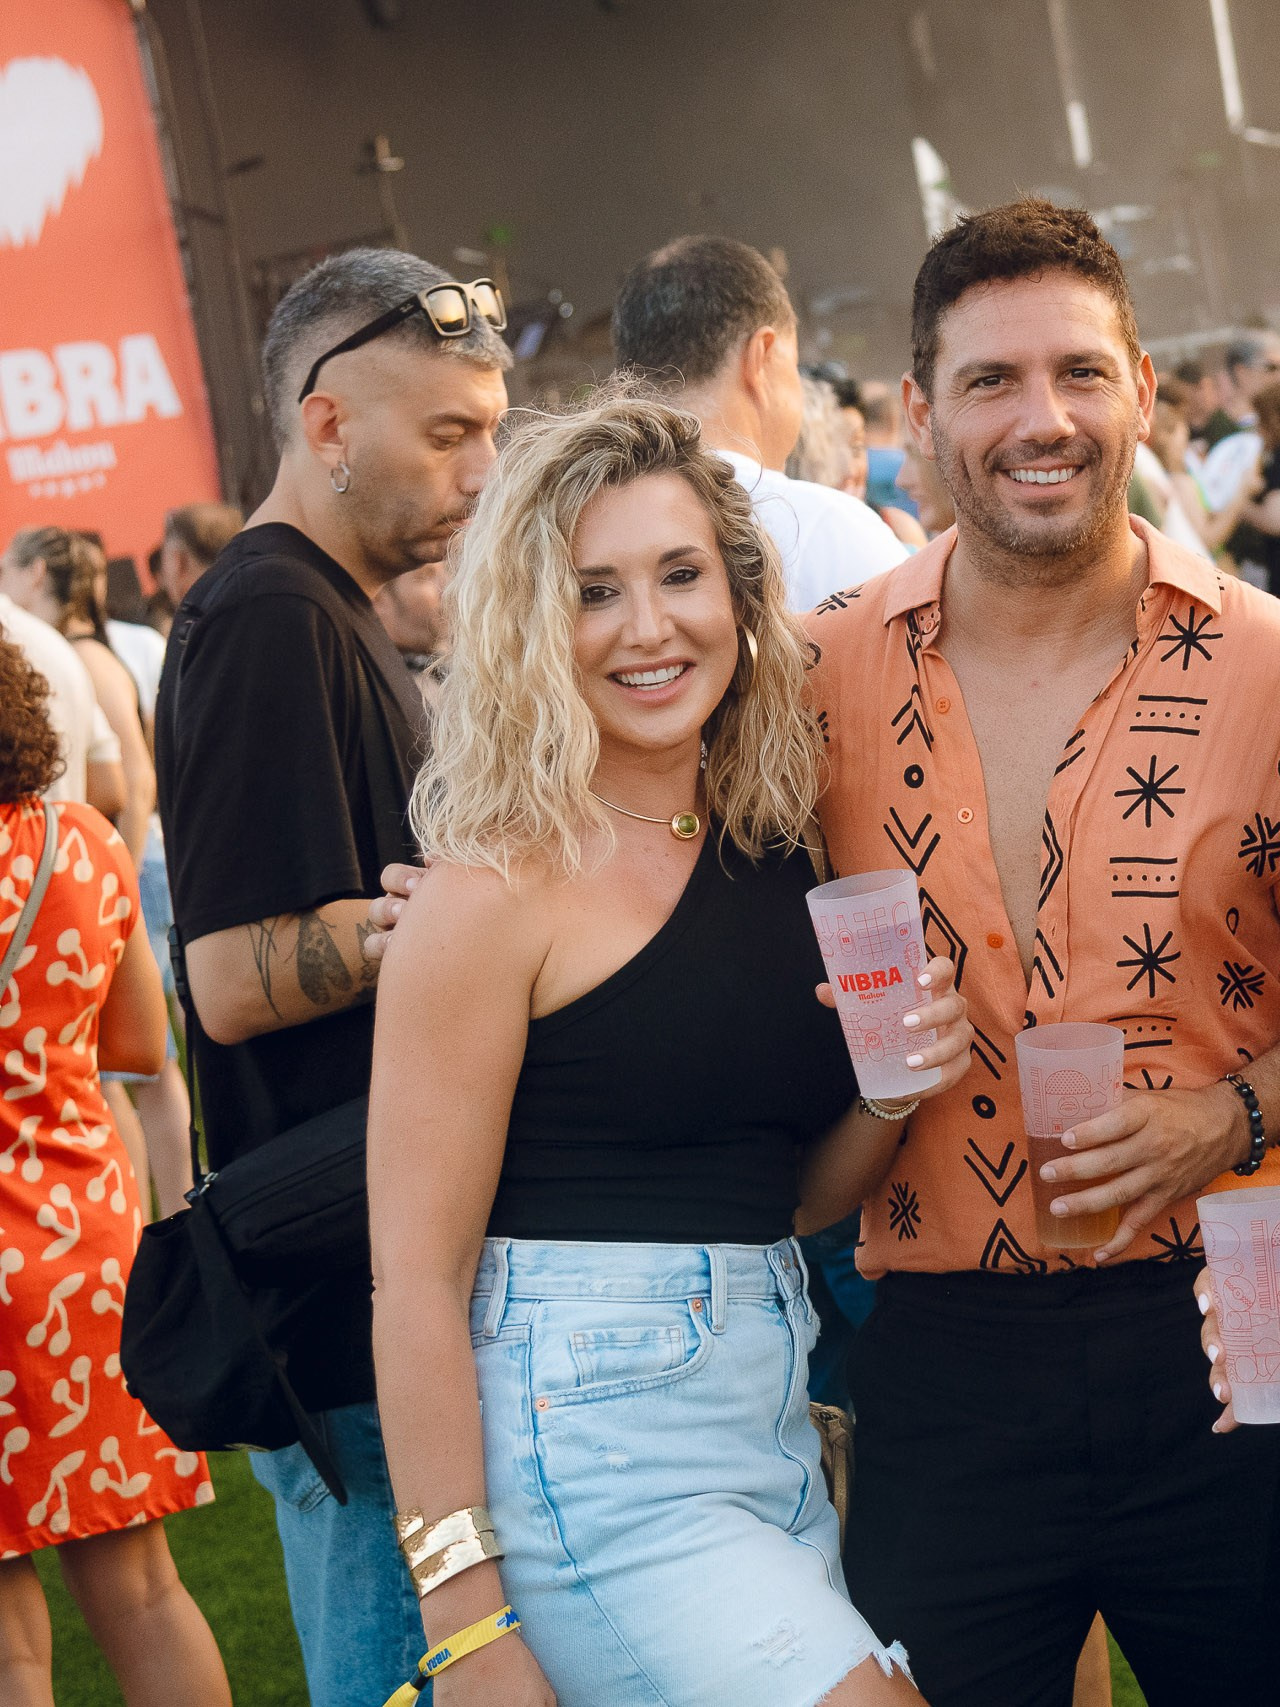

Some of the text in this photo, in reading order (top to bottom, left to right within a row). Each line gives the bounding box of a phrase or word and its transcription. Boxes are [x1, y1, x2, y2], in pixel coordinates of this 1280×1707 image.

[0, 333, 184, 442] BRA
[837, 967, 903, 992] VIBRA
[858, 992, 886, 1001] Mahou
[426, 1648, 452, 1672] VIBRA
